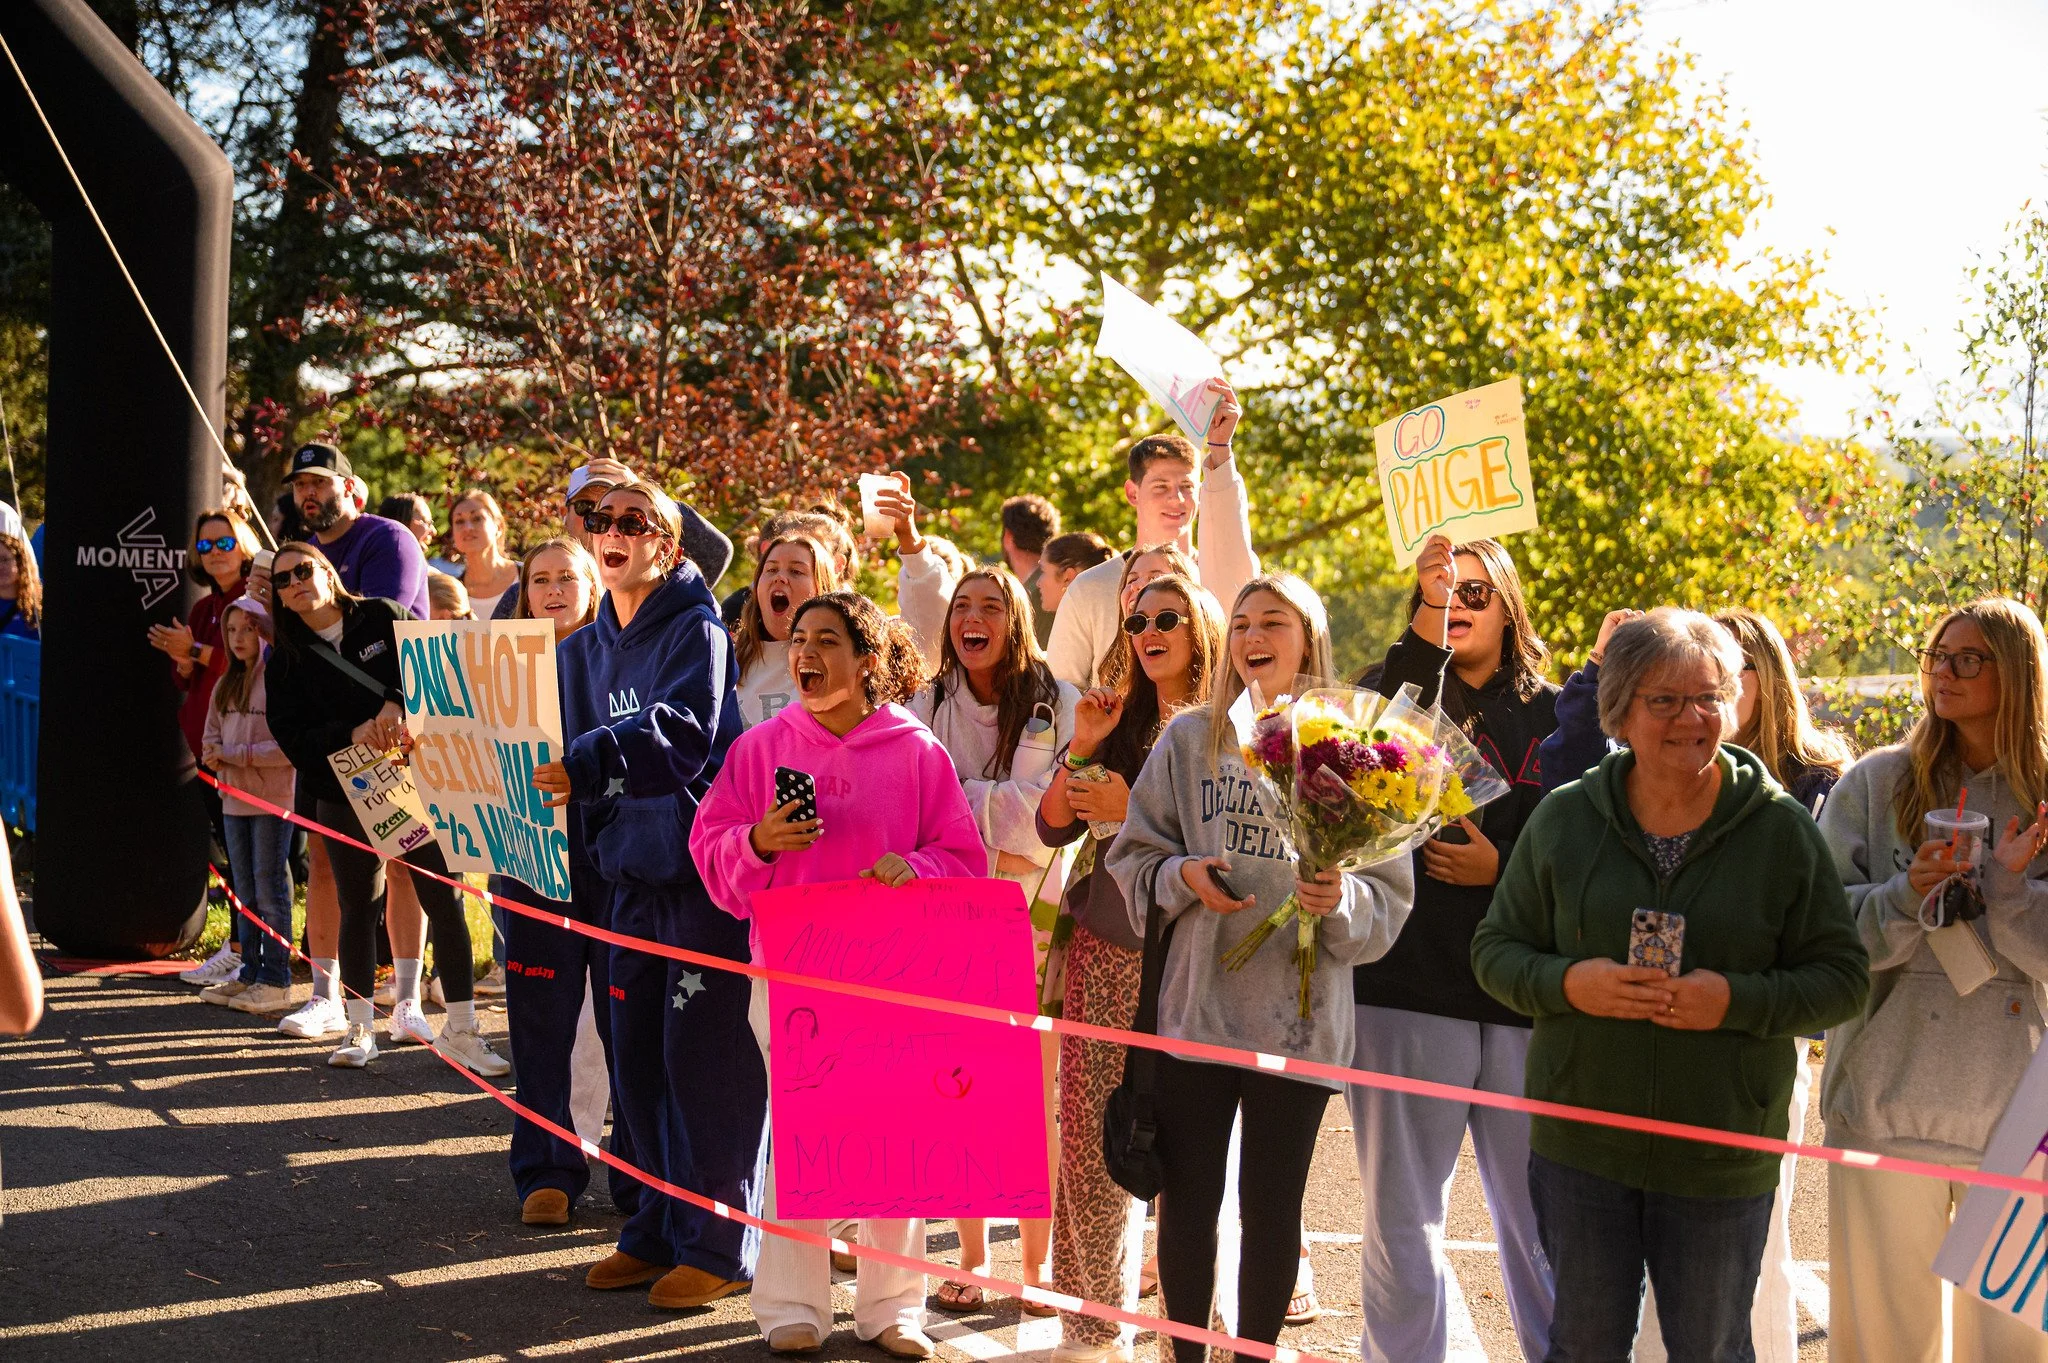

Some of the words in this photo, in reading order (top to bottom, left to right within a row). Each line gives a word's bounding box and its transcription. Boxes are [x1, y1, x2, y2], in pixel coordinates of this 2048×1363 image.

[1396, 408, 1441, 458] GO
[1391, 440, 1519, 543] PAIGE
[400, 632, 475, 719] ONLY
[464, 631, 546, 728] HOT
[363, 787, 396, 811] run
[373, 806, 407, 838] Brent
[1201, 775, 1264, 824] DELTA
[428, 803, 481, 858] 1/2
[507, 960, 523, 974] TRI
[525, 966, 555, 979] DELTA
[793, 1132, 1000, 1194] MOTION
